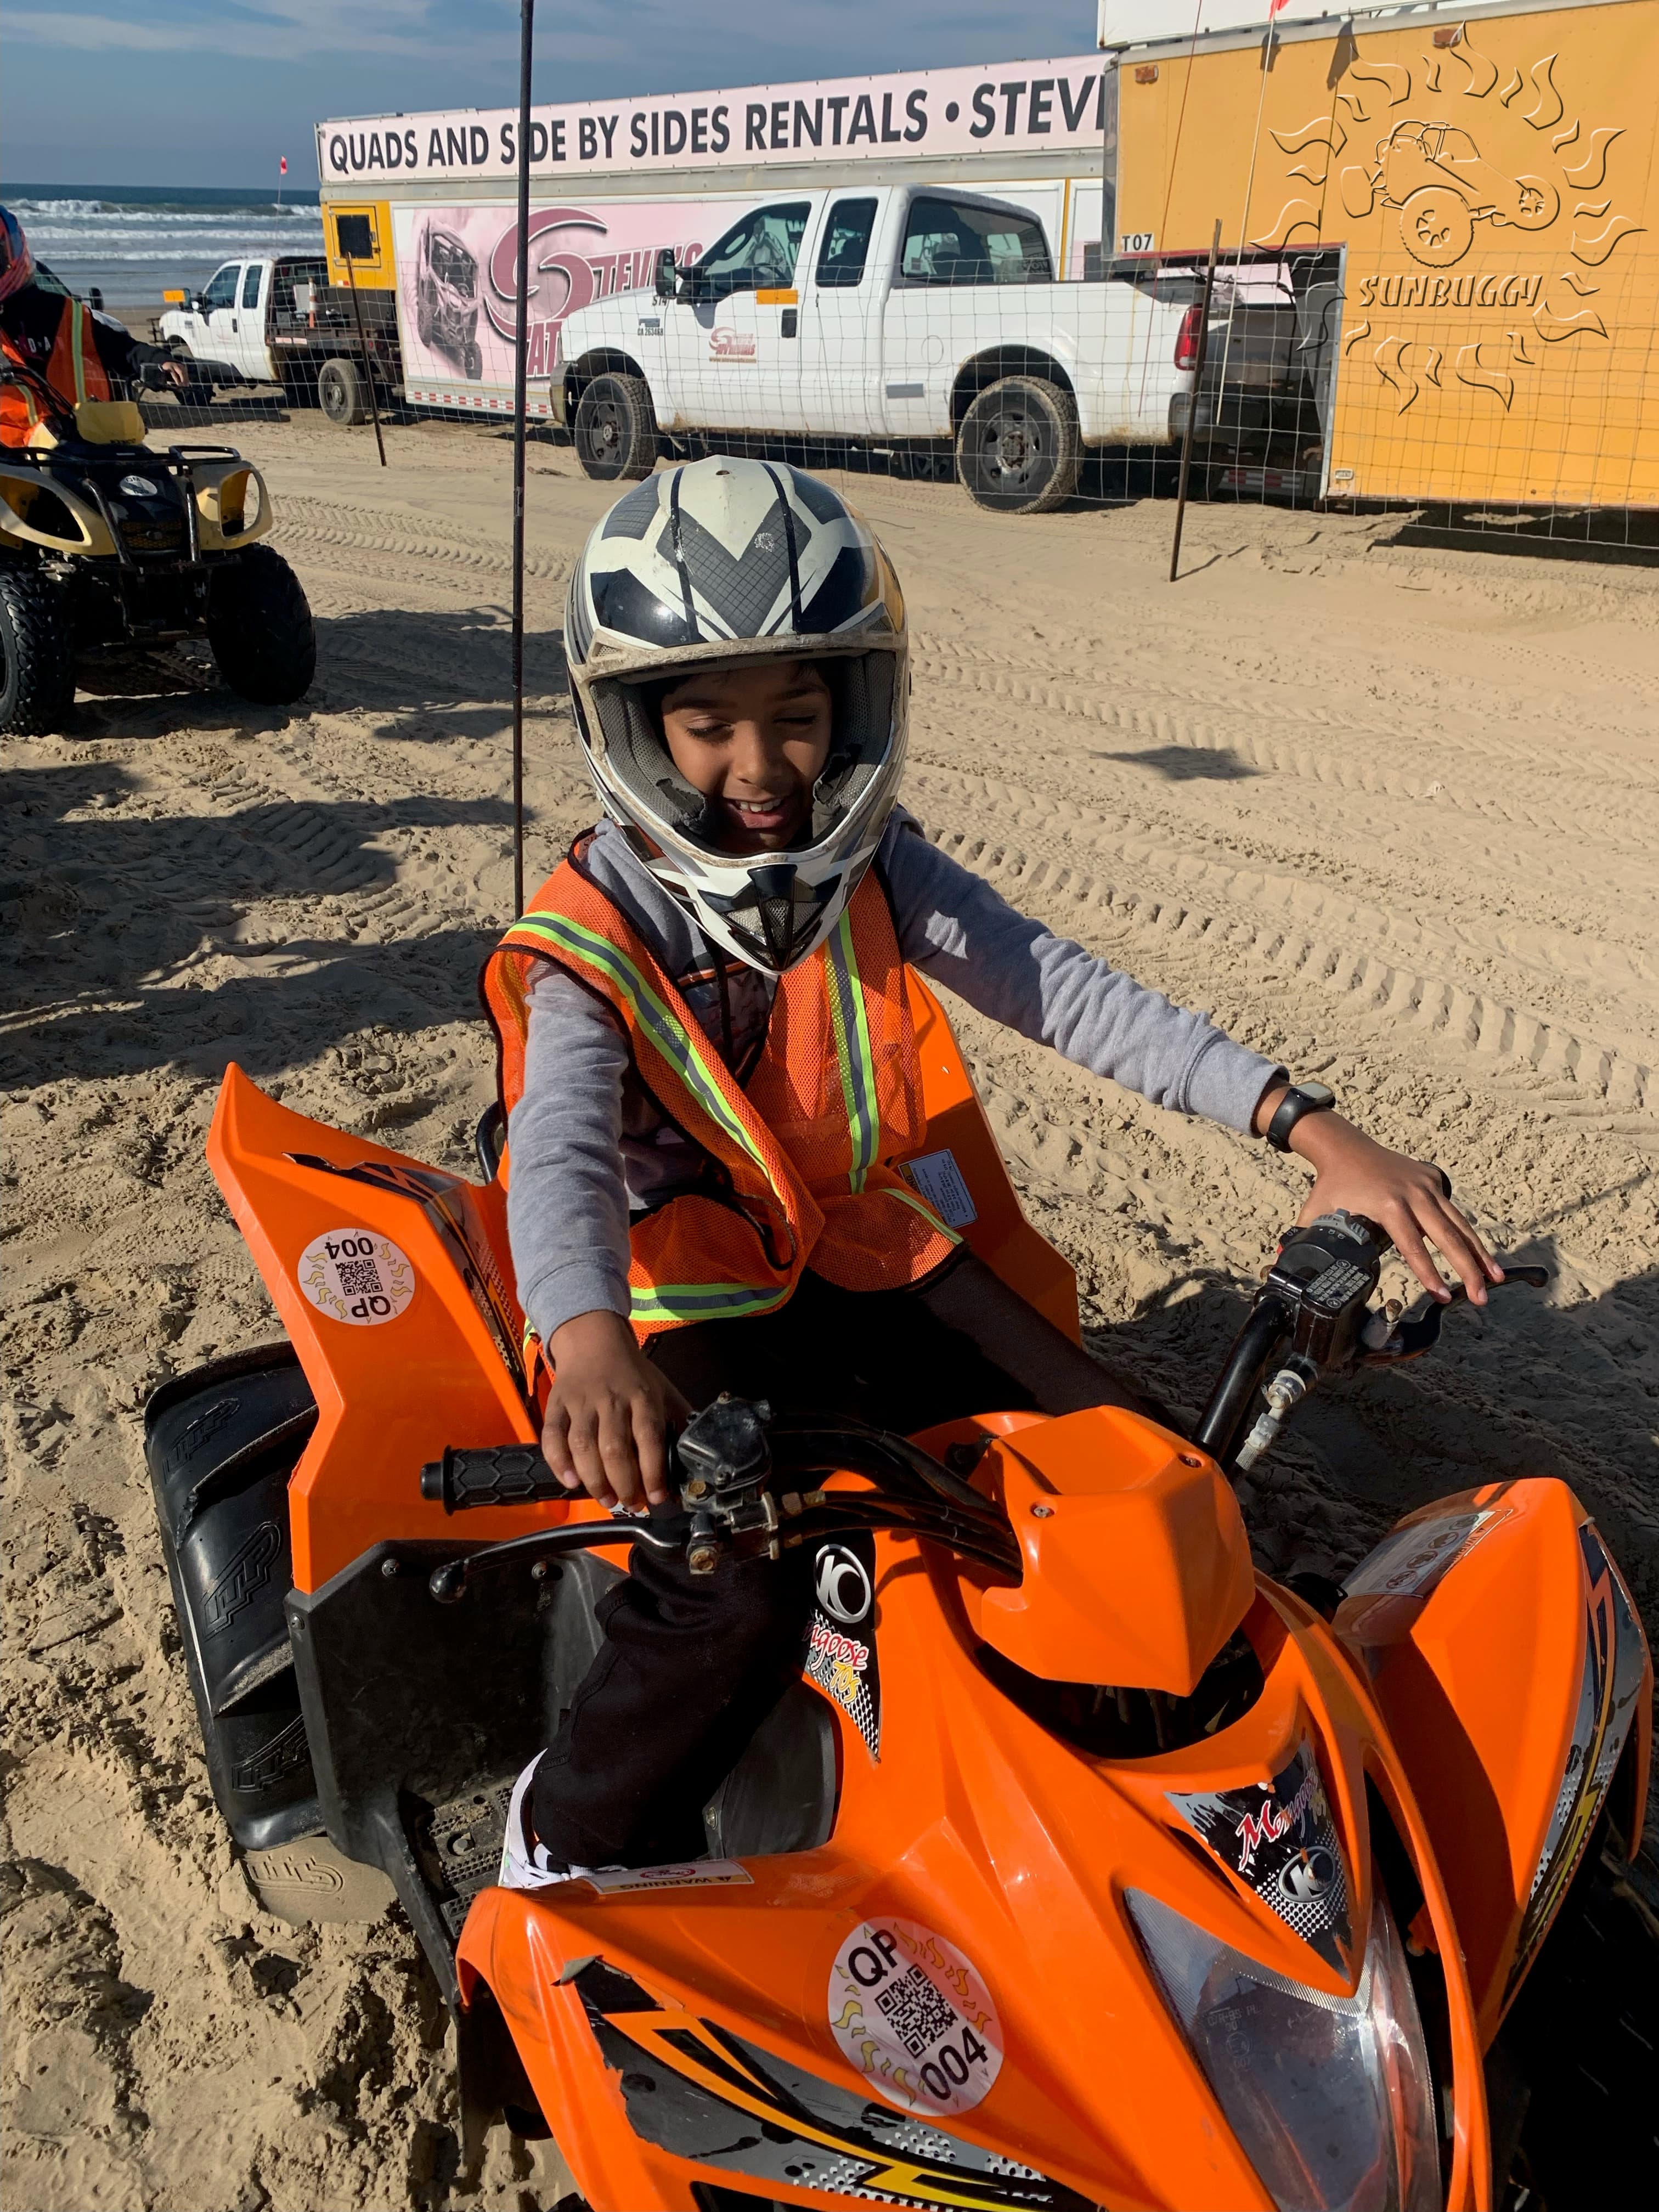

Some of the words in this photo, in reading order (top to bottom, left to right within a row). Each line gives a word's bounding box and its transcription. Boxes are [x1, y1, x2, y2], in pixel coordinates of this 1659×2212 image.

[329, 129, 418, 174] QUADS
[427, 125, 489, 167] AND
[579, 115, 619, 160] BY
[630, 105, 730, 158] SIDES
[745, 88, 928, 151] RENTALS
[1359, 275, 1543, 307] SUNBUGGY
[525, 320, 563, 377] AT
[325, 1237, 374, 1260] 004
[351, 1295, 391, 1318] QP
[619, 1877, 713, 1890] WARNING
[848, 1929, 898, 1988] QP
[919, 2026, 989, 2101] 004
